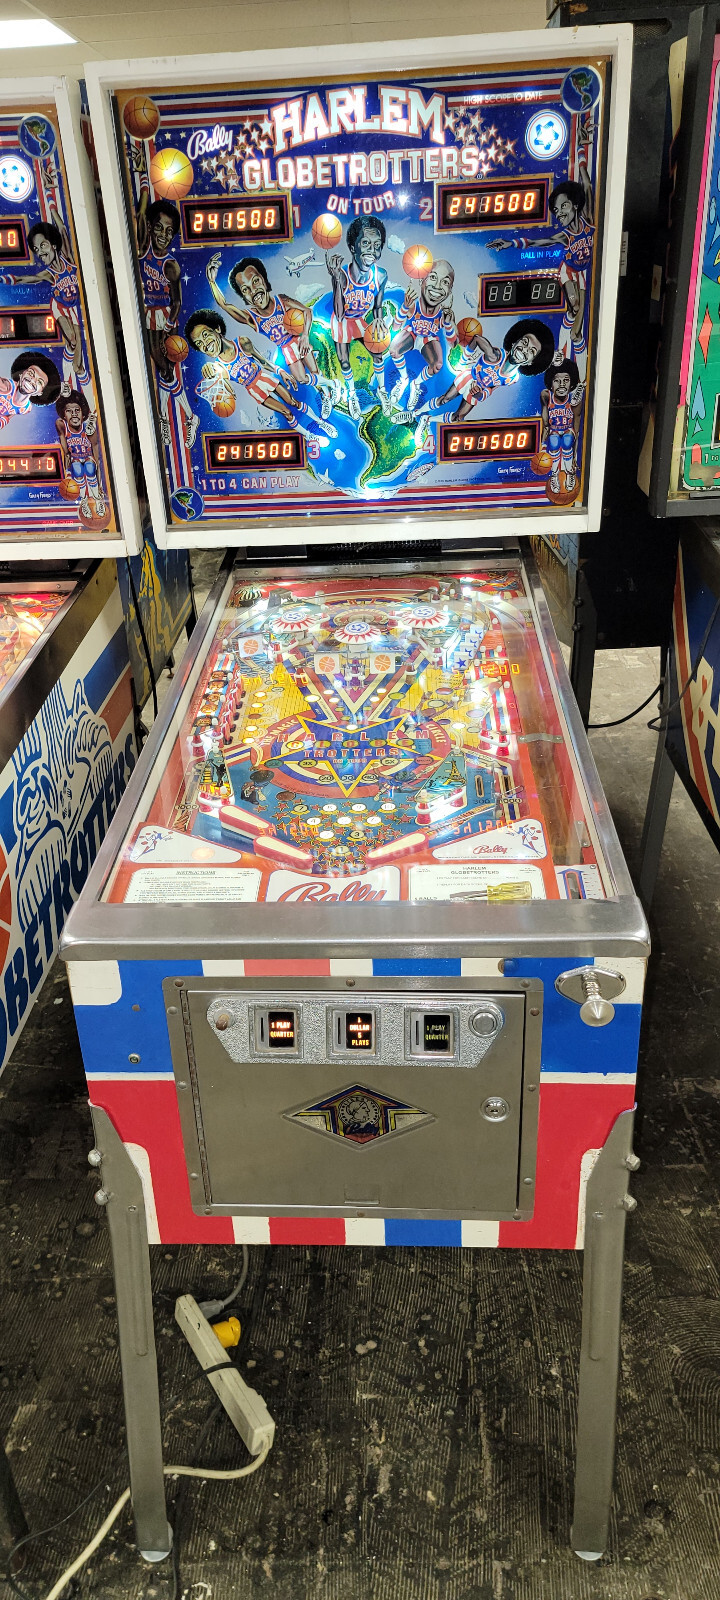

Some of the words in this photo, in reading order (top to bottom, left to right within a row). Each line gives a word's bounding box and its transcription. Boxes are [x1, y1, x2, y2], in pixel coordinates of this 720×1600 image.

[271, 85, 446, 156] HARLEM
[187, 123, 233, 160] Bally
[242, 146, 479, 192] GLOBETROTTERS
[327, 194, 349, 215] ON
[353, 190, 396, 215] TOUR
[420, 197, 433, 221] 2
[450, 192, 535, 216] 241500
[193, 208, 275, 232] 241500
[293, 205, 300, 228] 1
[520, 252, 536, 260] BALL
[545, 250, 561, 258] PLAY
[217, 442, 293, 461] 241500
[307, 439, 321, 459] 3
[422, 435, 436, 454] 4
[450, 432, 528, 452] 241500
[201, 479, 207, 490] 1
[210, 478, 226, 490] TO
[229, 478, 238, 489] 4
[242, 476, 267, 489] CAN
[270, 475, 301, 488] PLAY
[473, 845, 508, 854] Bally
[276, 1021, 291, 1029] PLAY
